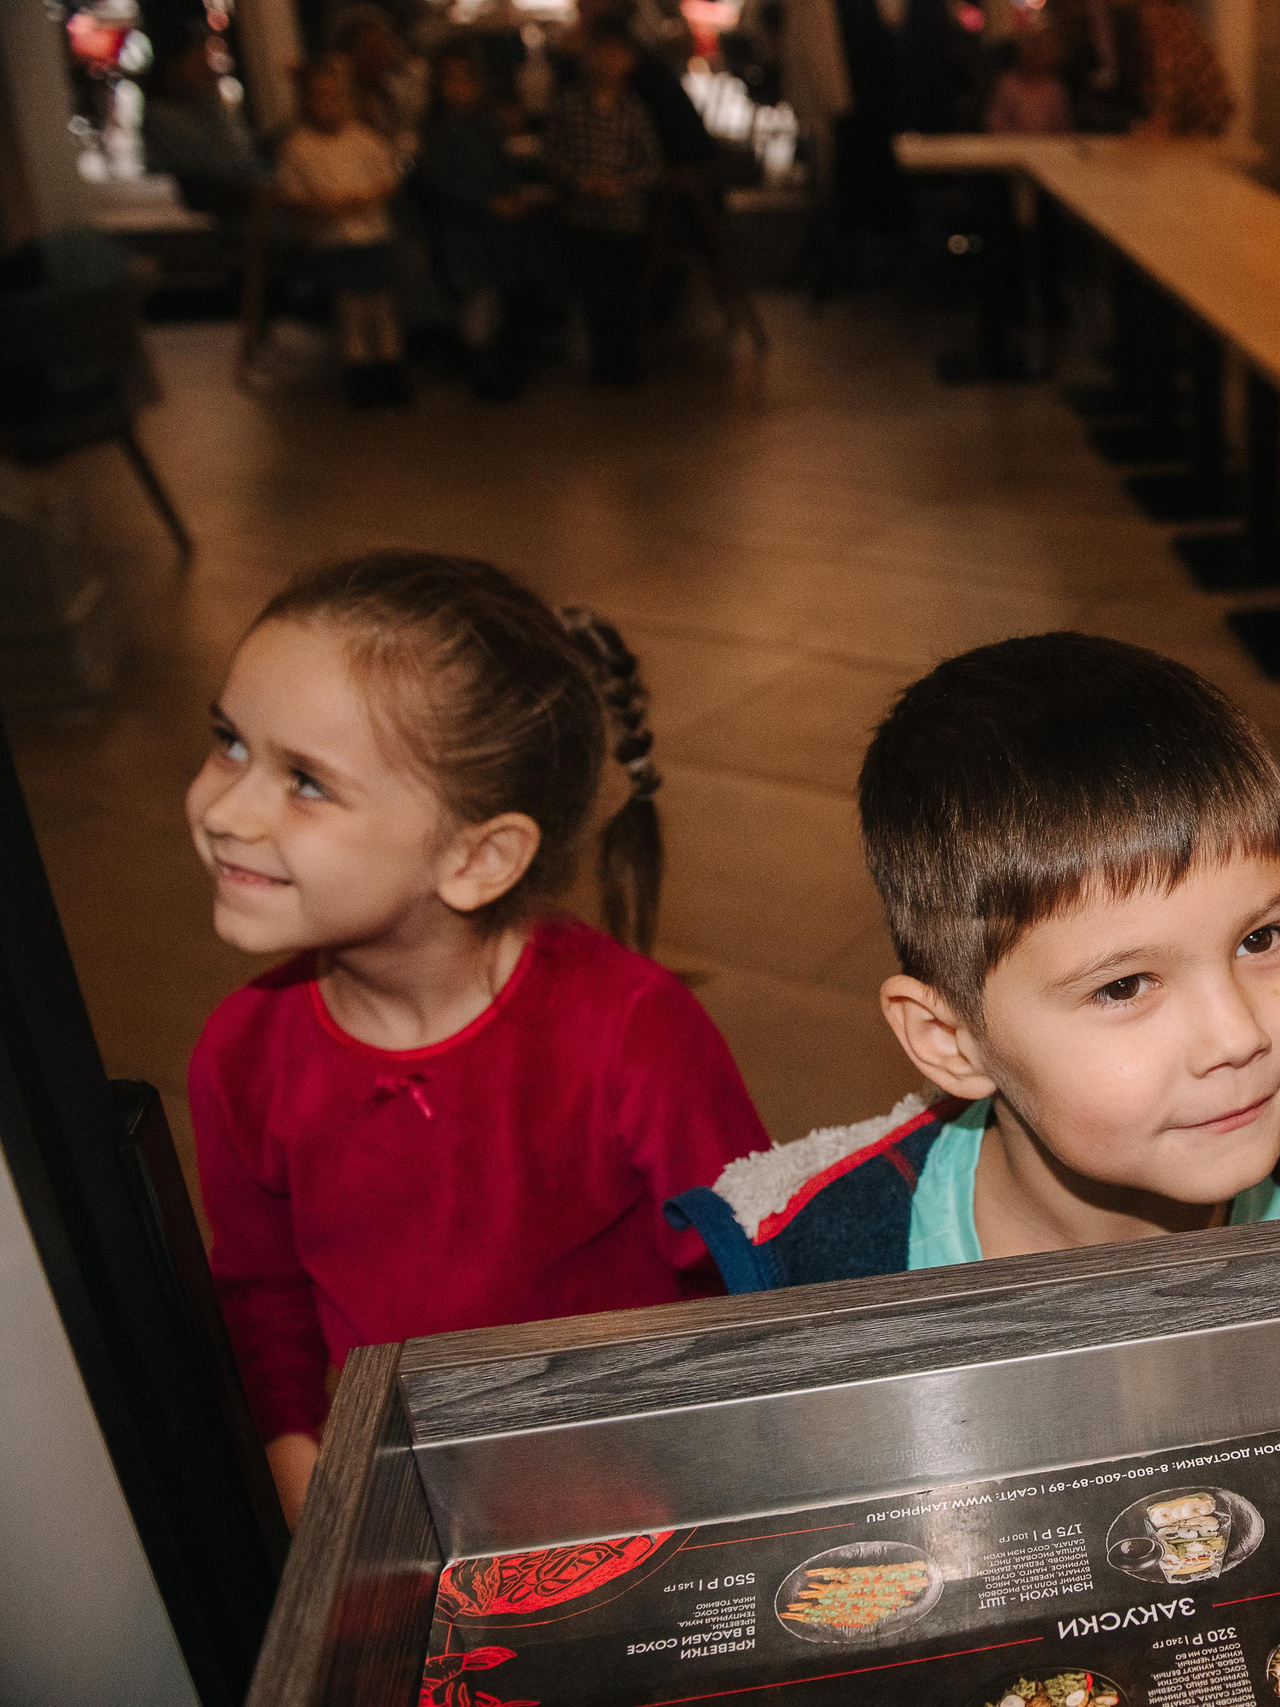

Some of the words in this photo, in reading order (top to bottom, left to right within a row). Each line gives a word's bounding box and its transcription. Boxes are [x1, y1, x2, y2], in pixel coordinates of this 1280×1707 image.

[1172, 1449, 1251, 1470] ДОСТАВКИ:
[1048, 1464, 1169, 1492] 8-800-600-89-89
[995, 1487, 1038, 1503] САЙТ:
[865, 1494, 992, 1524] WWW.IAMPHO.RU
[1041, 1529, 1052, 1539] Р
[1057, 1524, 1082, 1536] 175
[1056, 1546, 1086, 1554] ЛАПША
[984, 1552, 1005, 1560] КУОН
[1013, 1560, 1044, 1569] РЕДЬКА
[708, 1578, 718, 1589] Р
[725, 1573, 755, 1587] 550
[1035, 1580, 1057, 1588] РОЛЛ
[1060, 1574, 1092, 1583] СПРИНГ
[664, 1585, 675, 1593] ГР
[679, 1582, 693, 1590] 145
[986, 1581, 1010, 1589] МЯСО
[1063, 1582, 1093, 1593] НЭМ
[979, 1587, 1020, 1599] РИСОВОЙ
[1020, 1588, 1058, 1601] КУОН
[697, 1600, 730, 1610] ТОБИКО
[734, 1596, 755, 1604] ИКРА
[978, 1597, 1006, 1608] 1ШТ
[722, 1603, 755, 1613] ВАСАБИ
[706, 1610, 755, 1624] ТЕМПУРНАЯ
[1058, 1598, 1196, 1639] ЗАКУСКИ
[747, 1626, 755, 1635] В
[1208, 1627, 1237, 1642] 320
[683, 1628, 741, 1646] ВАСАБИ
[1166, 1638, 1183, 1646] 240
[1192, 1633, 1203, 1645] Р
[628, 1638, 677, 1655] СОУСЕ
[681, 1638, 755, 1660] КРЕВЕТКИ
[1152, 1641, 1164, 1649] ГР
[1219, 1643, 1240, 1651] СОУС
[1212, 1650, 1242, 1660] КУНЖУТ
[1183, 1664, 1214, 1673] КУНЖУТ
[1158, 1676, 1189, 1686] РОСТКИ
[1148, 1685, 1182, 1696] СОЕВЫЙ
[1189, 1685, 1222, 1697] ЯИЧНЫЙ
[1232, 1687, 1252, 1695] ЛИСТ
[1149, 1692, 1187, 1703] БЛИНЧИК
